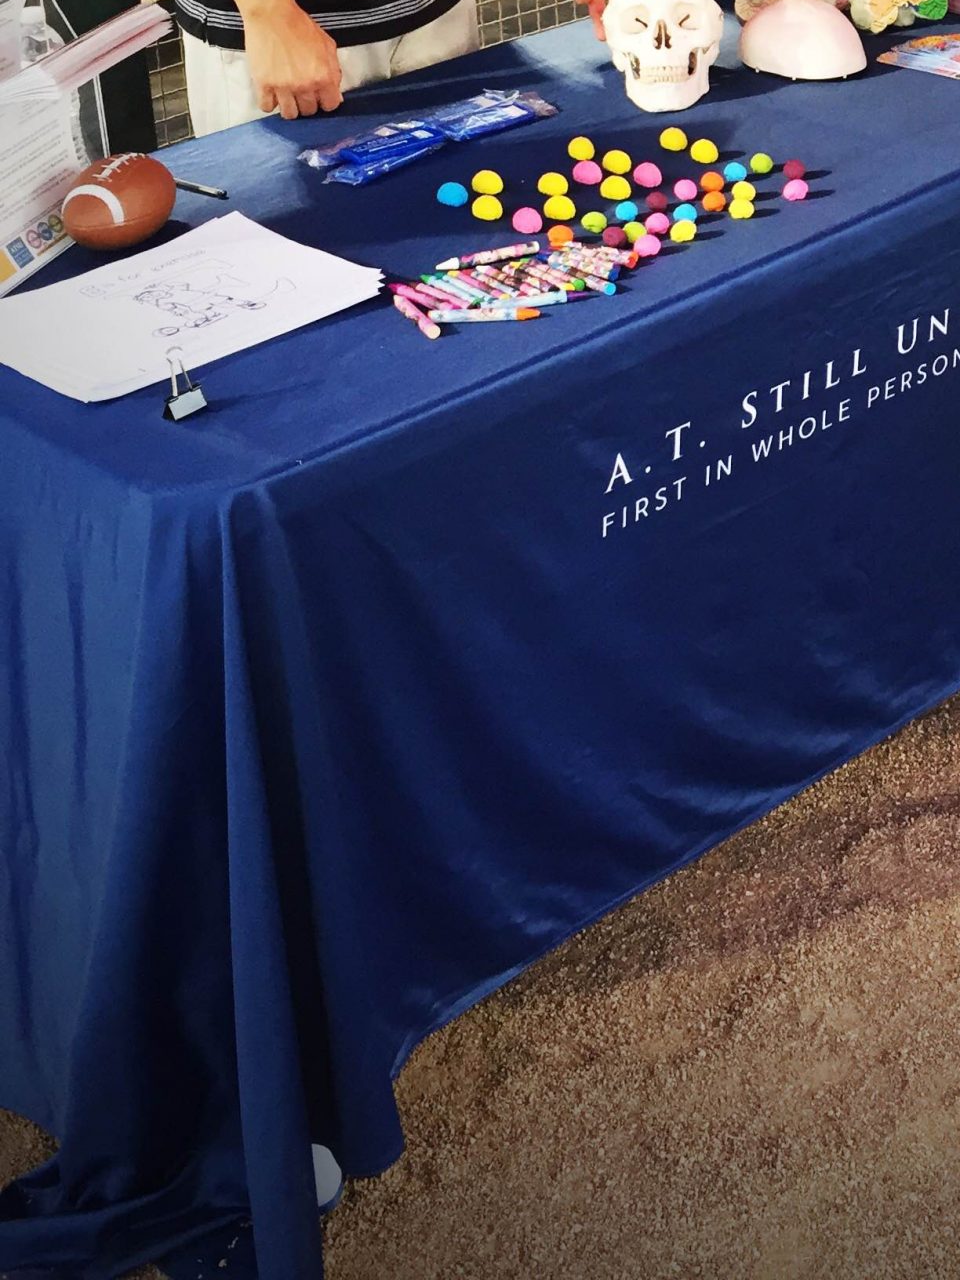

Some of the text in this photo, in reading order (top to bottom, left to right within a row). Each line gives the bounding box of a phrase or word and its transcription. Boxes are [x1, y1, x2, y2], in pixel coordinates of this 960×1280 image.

[741, 348, 868, 430] STILL
[602, 475, 688, 538] FIRST
[705, 454, 733, 487] IN
[751, 399, 852, 463] WHOLE
